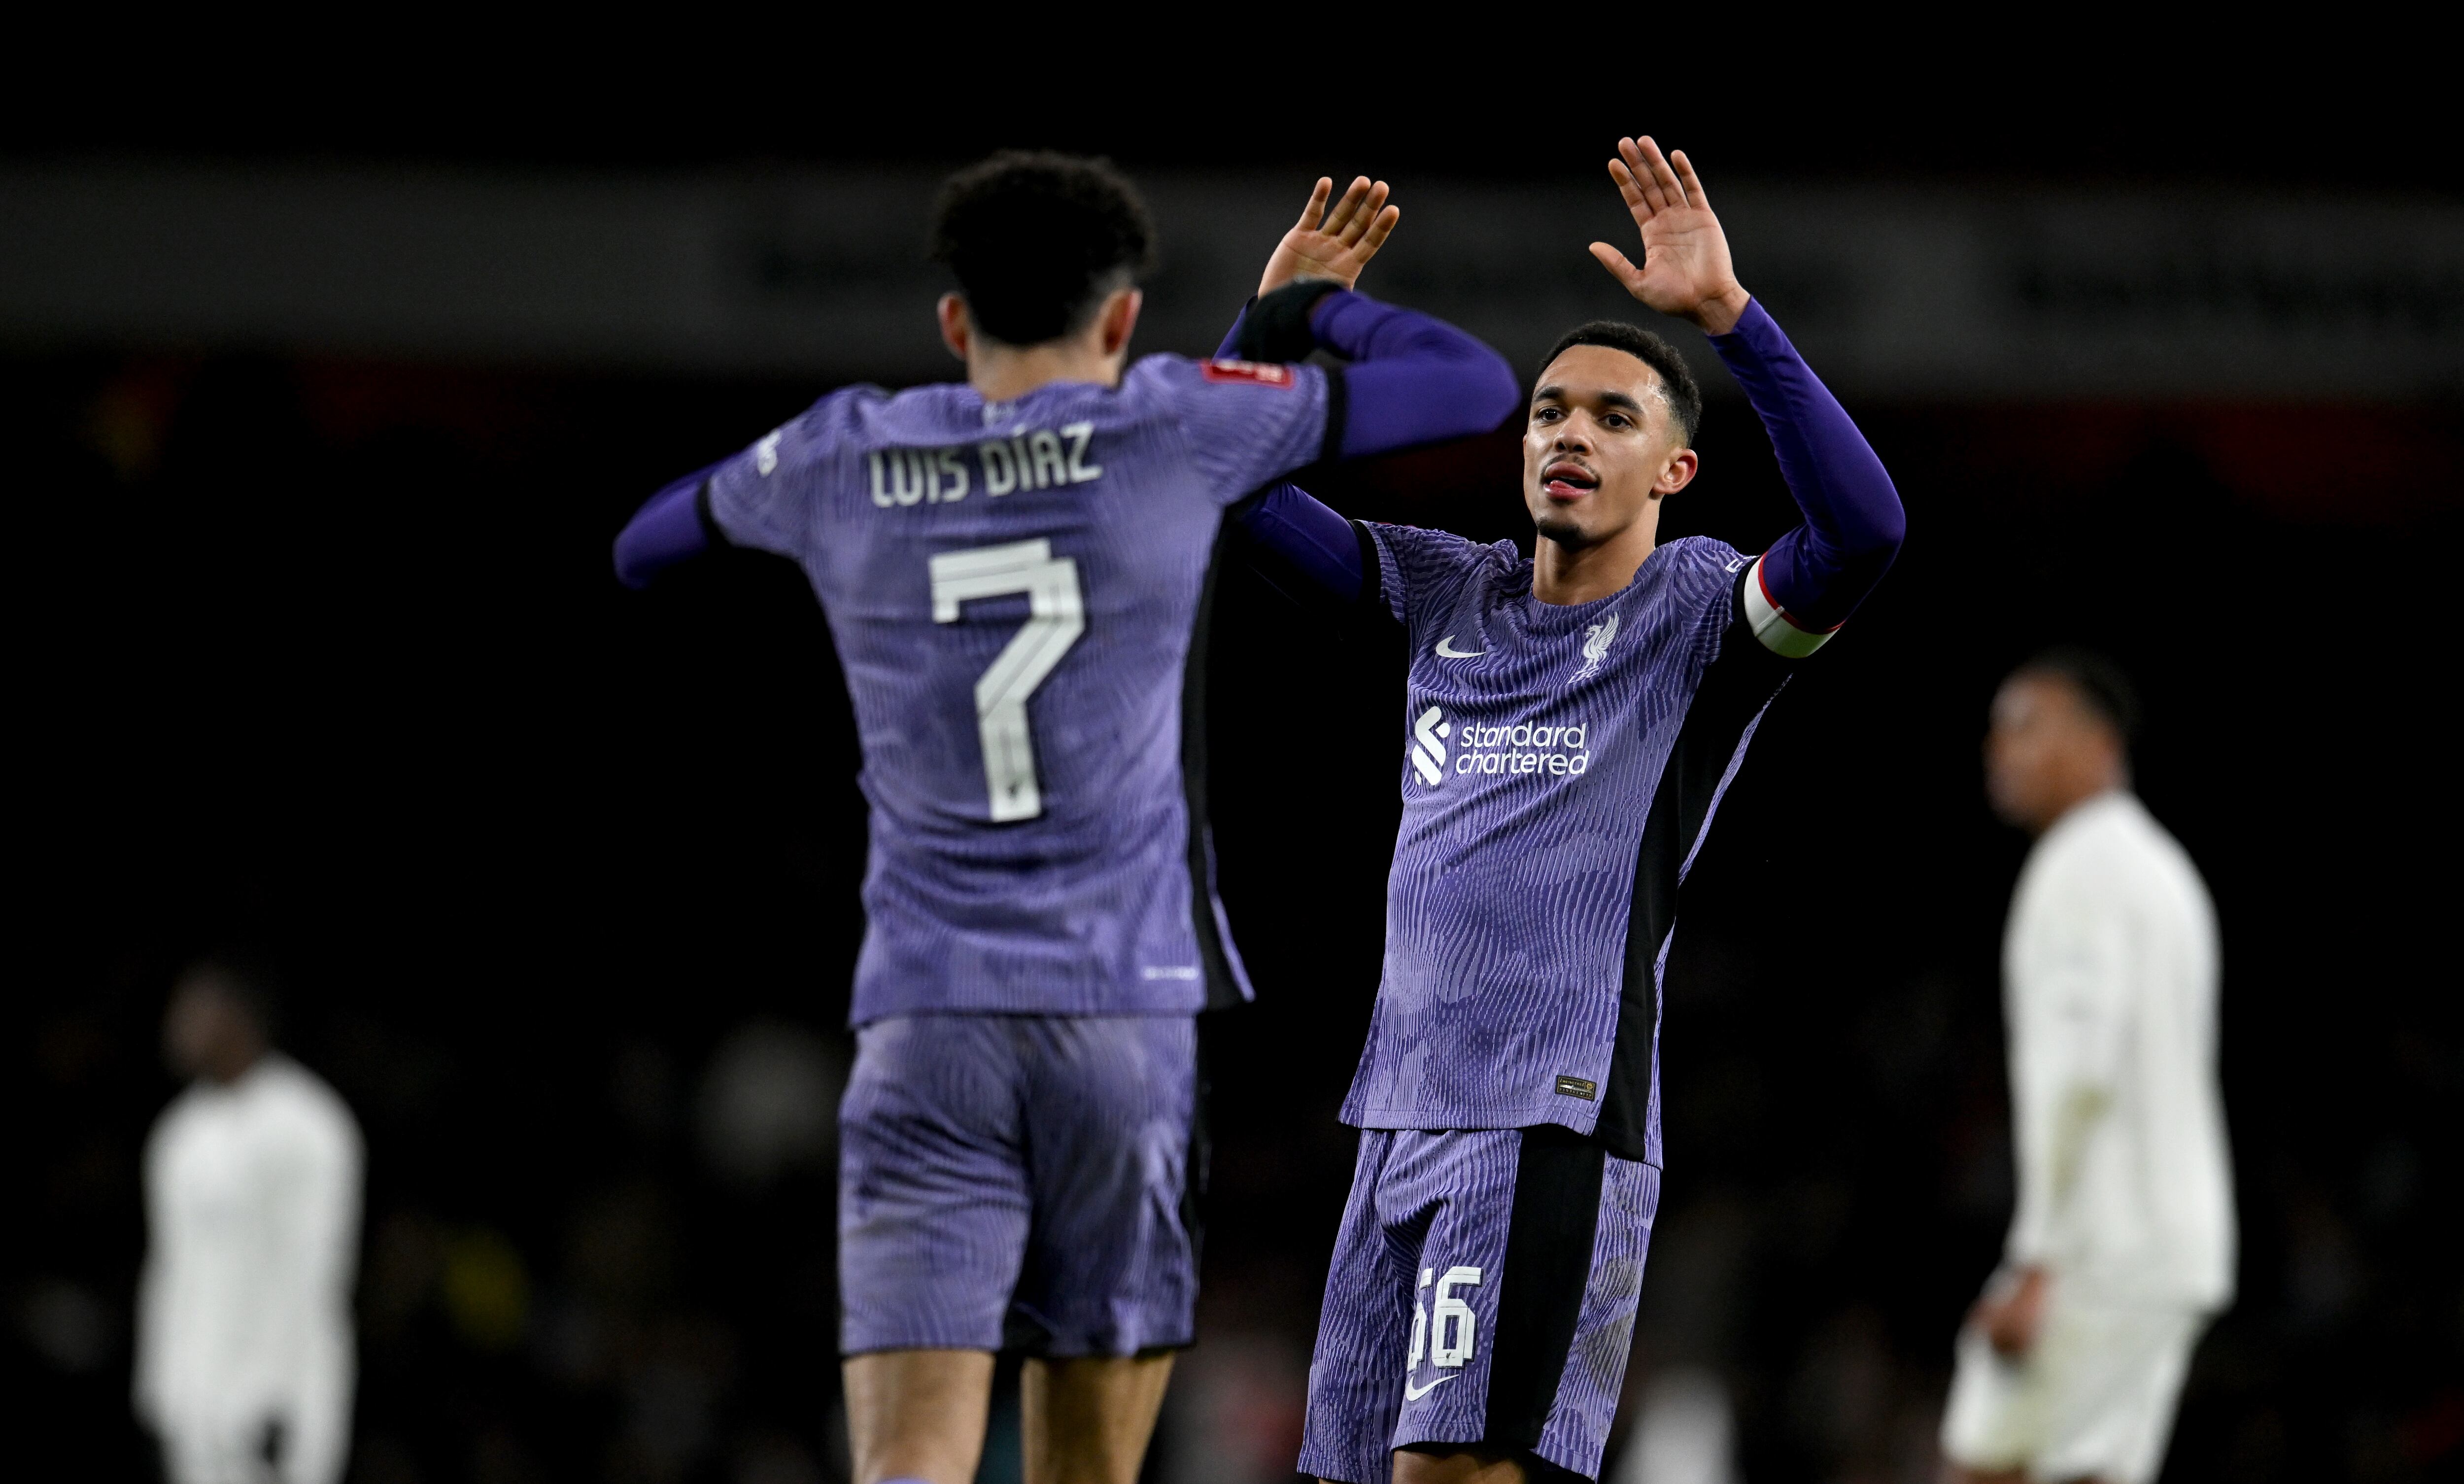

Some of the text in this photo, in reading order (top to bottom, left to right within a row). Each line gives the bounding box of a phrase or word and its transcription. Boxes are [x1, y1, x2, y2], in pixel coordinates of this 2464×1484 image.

[869, 421, 1103, 508] LUIS DÍAZ
[929, 537, 1085, 822] 7
[1456, 748, 1590, 776] chartered
[1460, 720, 1586, 749] standard
